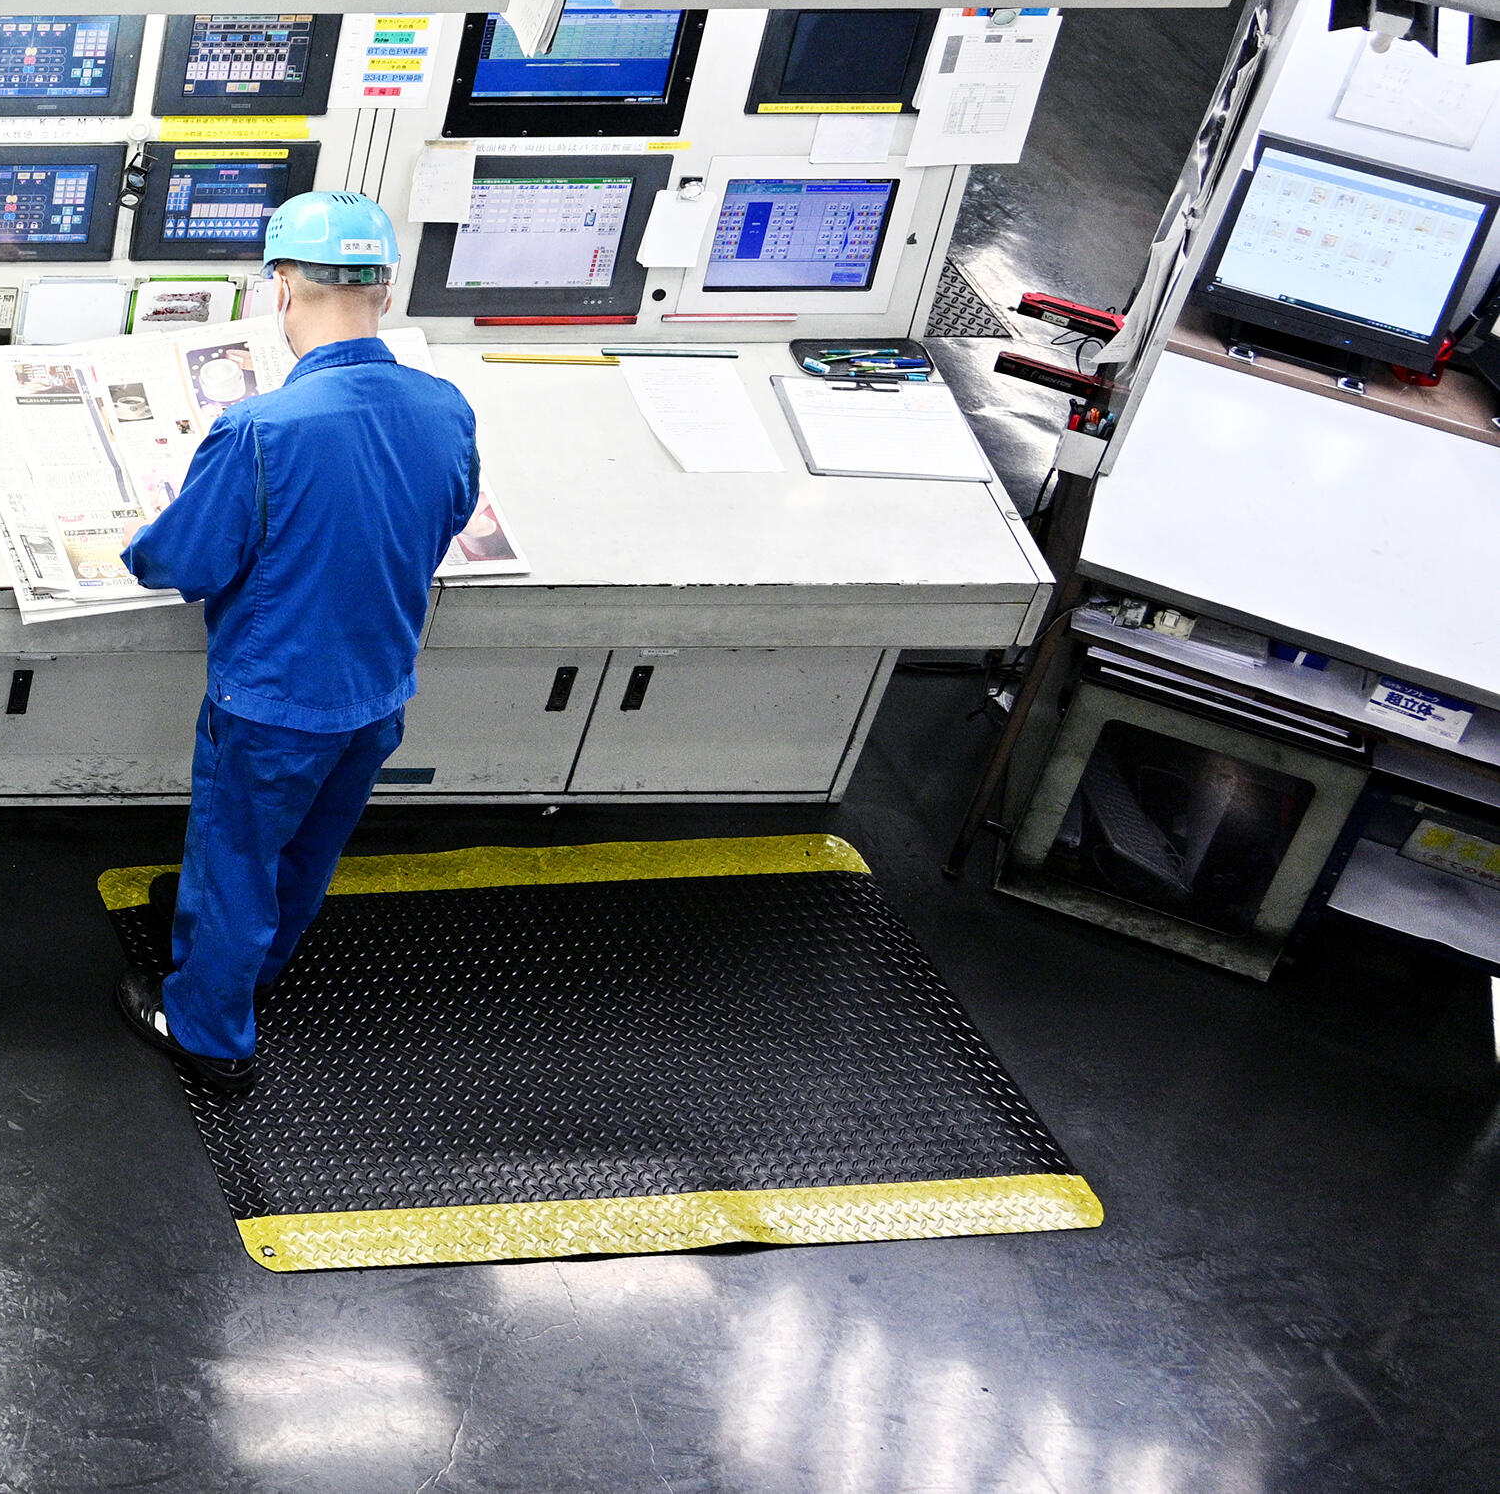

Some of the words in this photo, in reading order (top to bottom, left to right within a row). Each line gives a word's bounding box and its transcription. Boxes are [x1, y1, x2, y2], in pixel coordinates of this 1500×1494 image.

[39, 118, 47, 126] K
[58, 118, 66, 126] C
[1384, 690, 1434, 717] 超立体
[1403, 685, 1440, 704] ソフトーク
